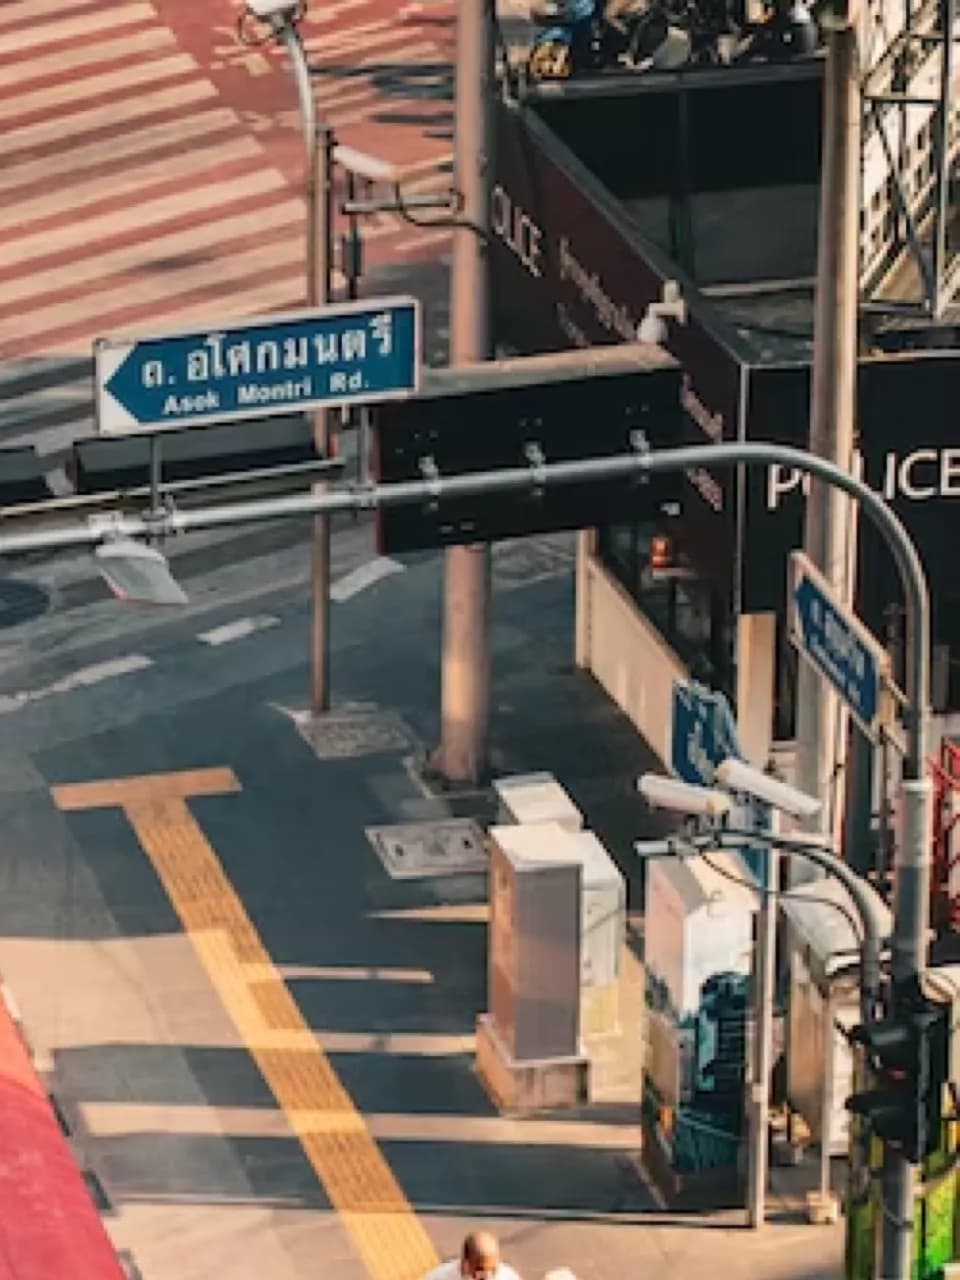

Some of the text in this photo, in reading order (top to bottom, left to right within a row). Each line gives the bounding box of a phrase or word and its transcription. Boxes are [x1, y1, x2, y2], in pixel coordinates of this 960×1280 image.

[162, 371, 370, 416] Asok Montri Rd.
[768, 448, 960, 510] PLICE
